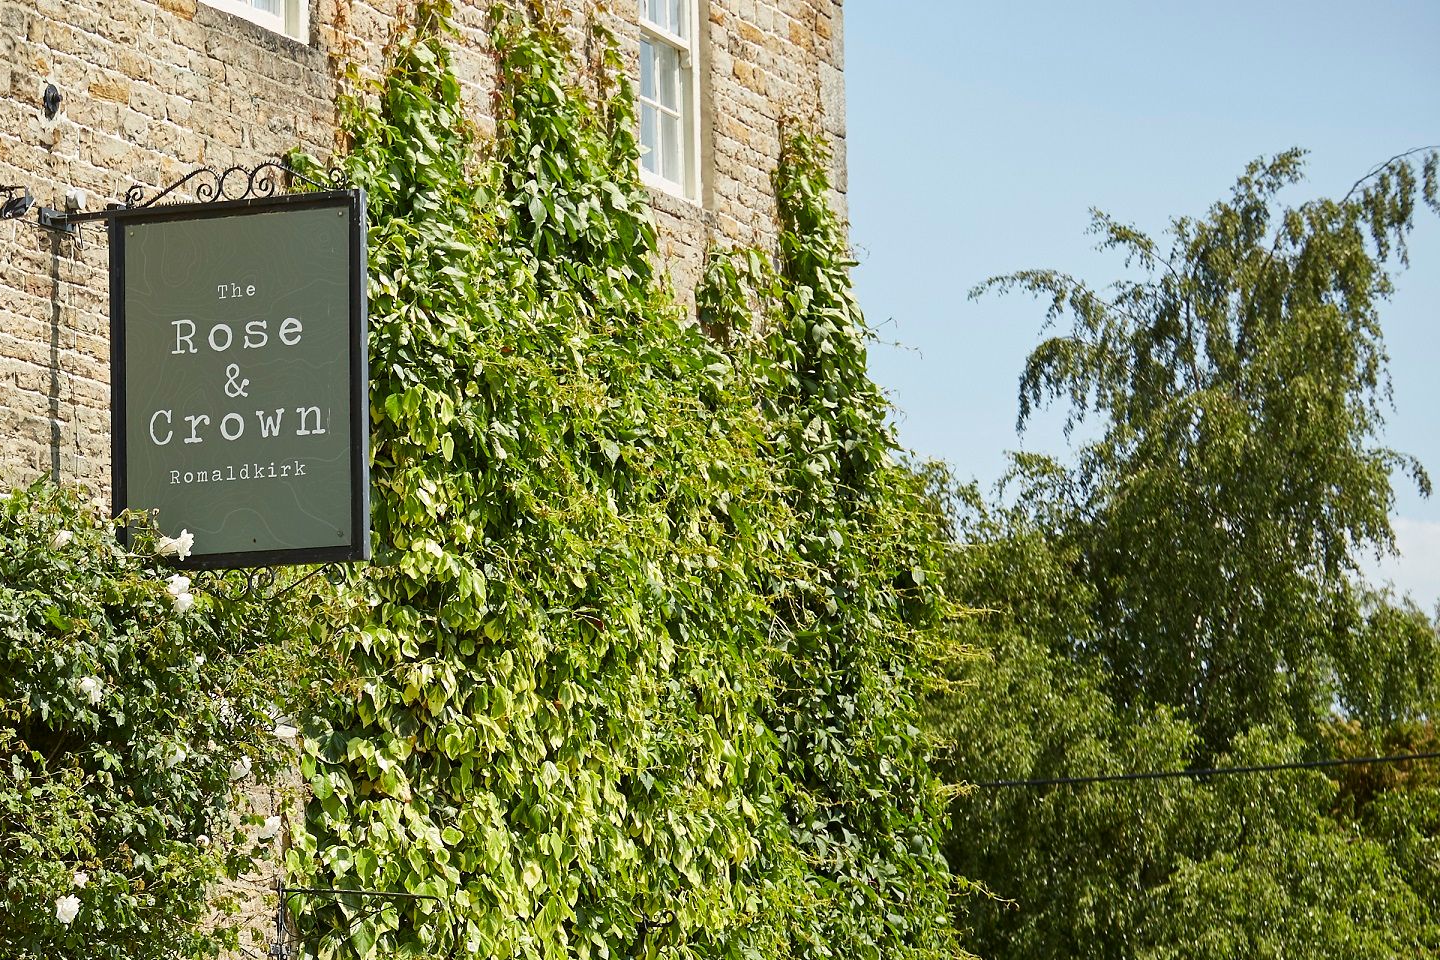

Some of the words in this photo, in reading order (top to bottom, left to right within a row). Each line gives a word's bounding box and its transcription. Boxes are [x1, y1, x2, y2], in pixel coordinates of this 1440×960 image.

[217, 283, 256, 299] The
[171, 317, 303, 354] Rose
[224, 363, 250, 398] &
[149, 405, 325, 446] Crown
[170, 461, 307, 484] Romaldkirk
